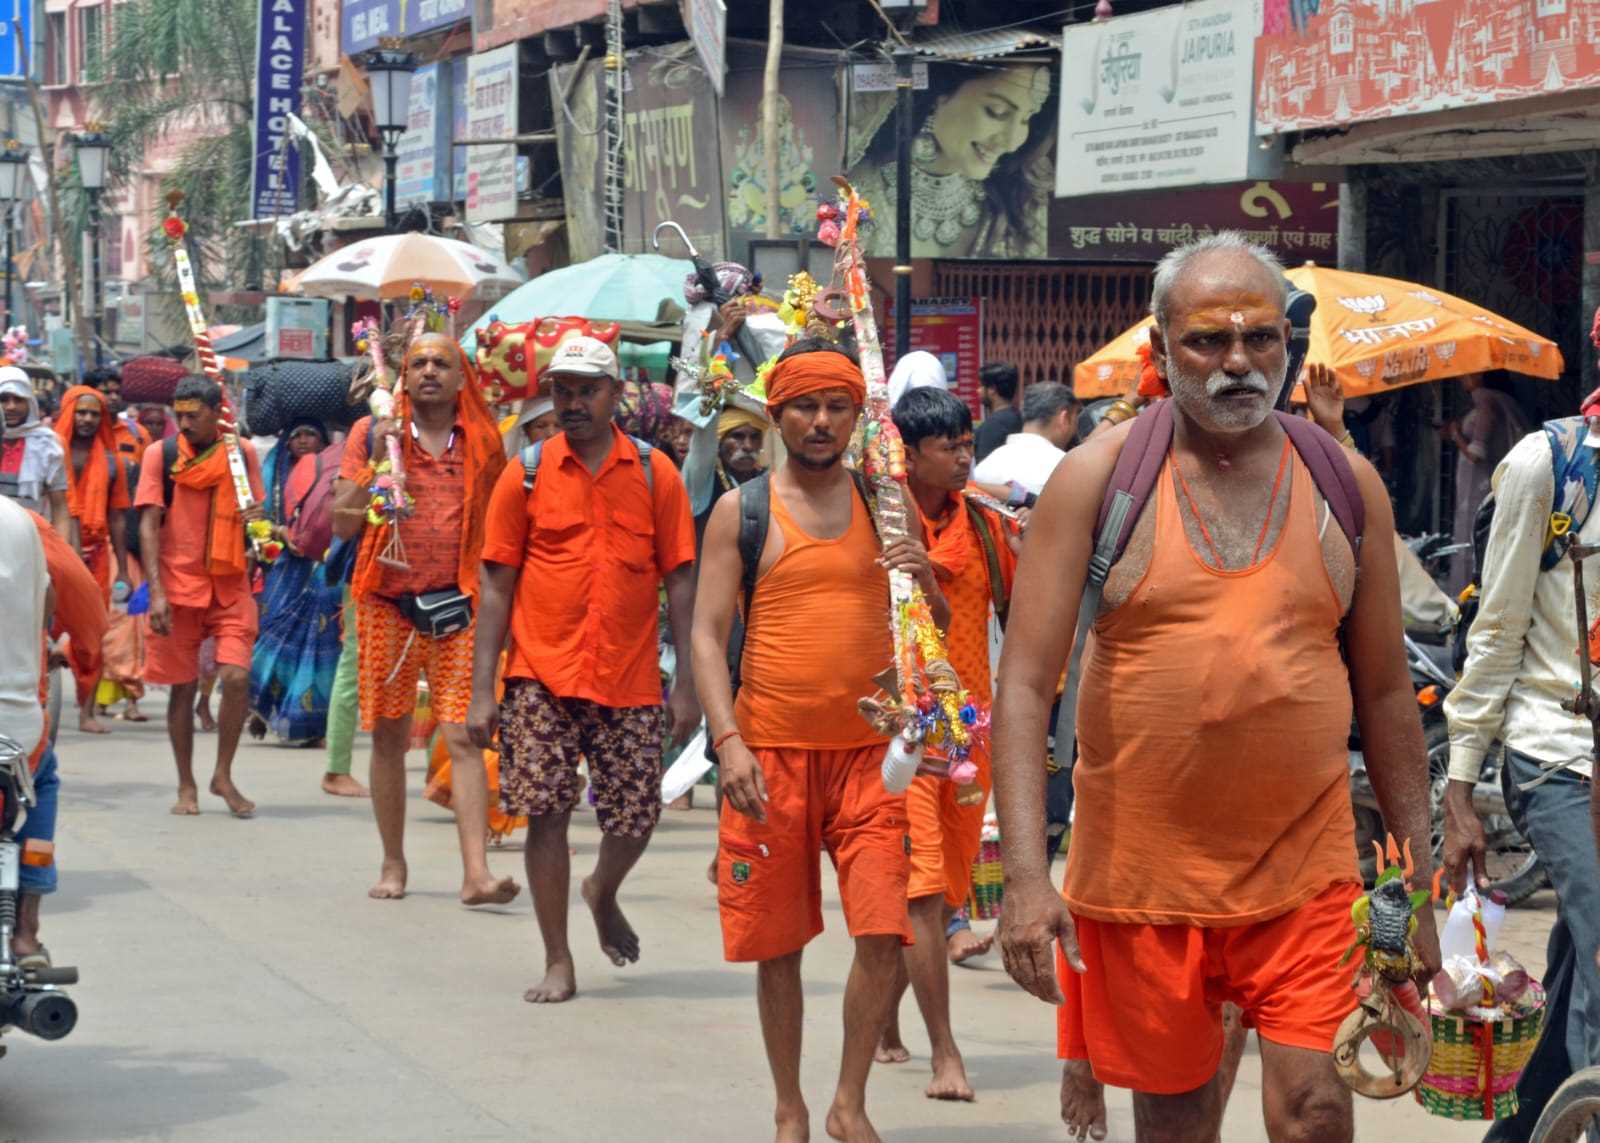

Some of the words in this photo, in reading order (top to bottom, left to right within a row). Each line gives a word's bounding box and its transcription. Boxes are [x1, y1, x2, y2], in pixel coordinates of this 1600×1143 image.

[1181, 30, 1235, 64] JAIPURIA
[267, 97, 292, 189] HOTEL
[1070, 226, 1101, 248] शुद्ध
[1105, 222, 1138, 243] सोने
[1141, 228, 1153, 243] व
[1283, 227, 1304, 249] एवं
[1309, 233, 1331, 250] ग्रह
[1338, 317, 1438, 344] भाजपा
